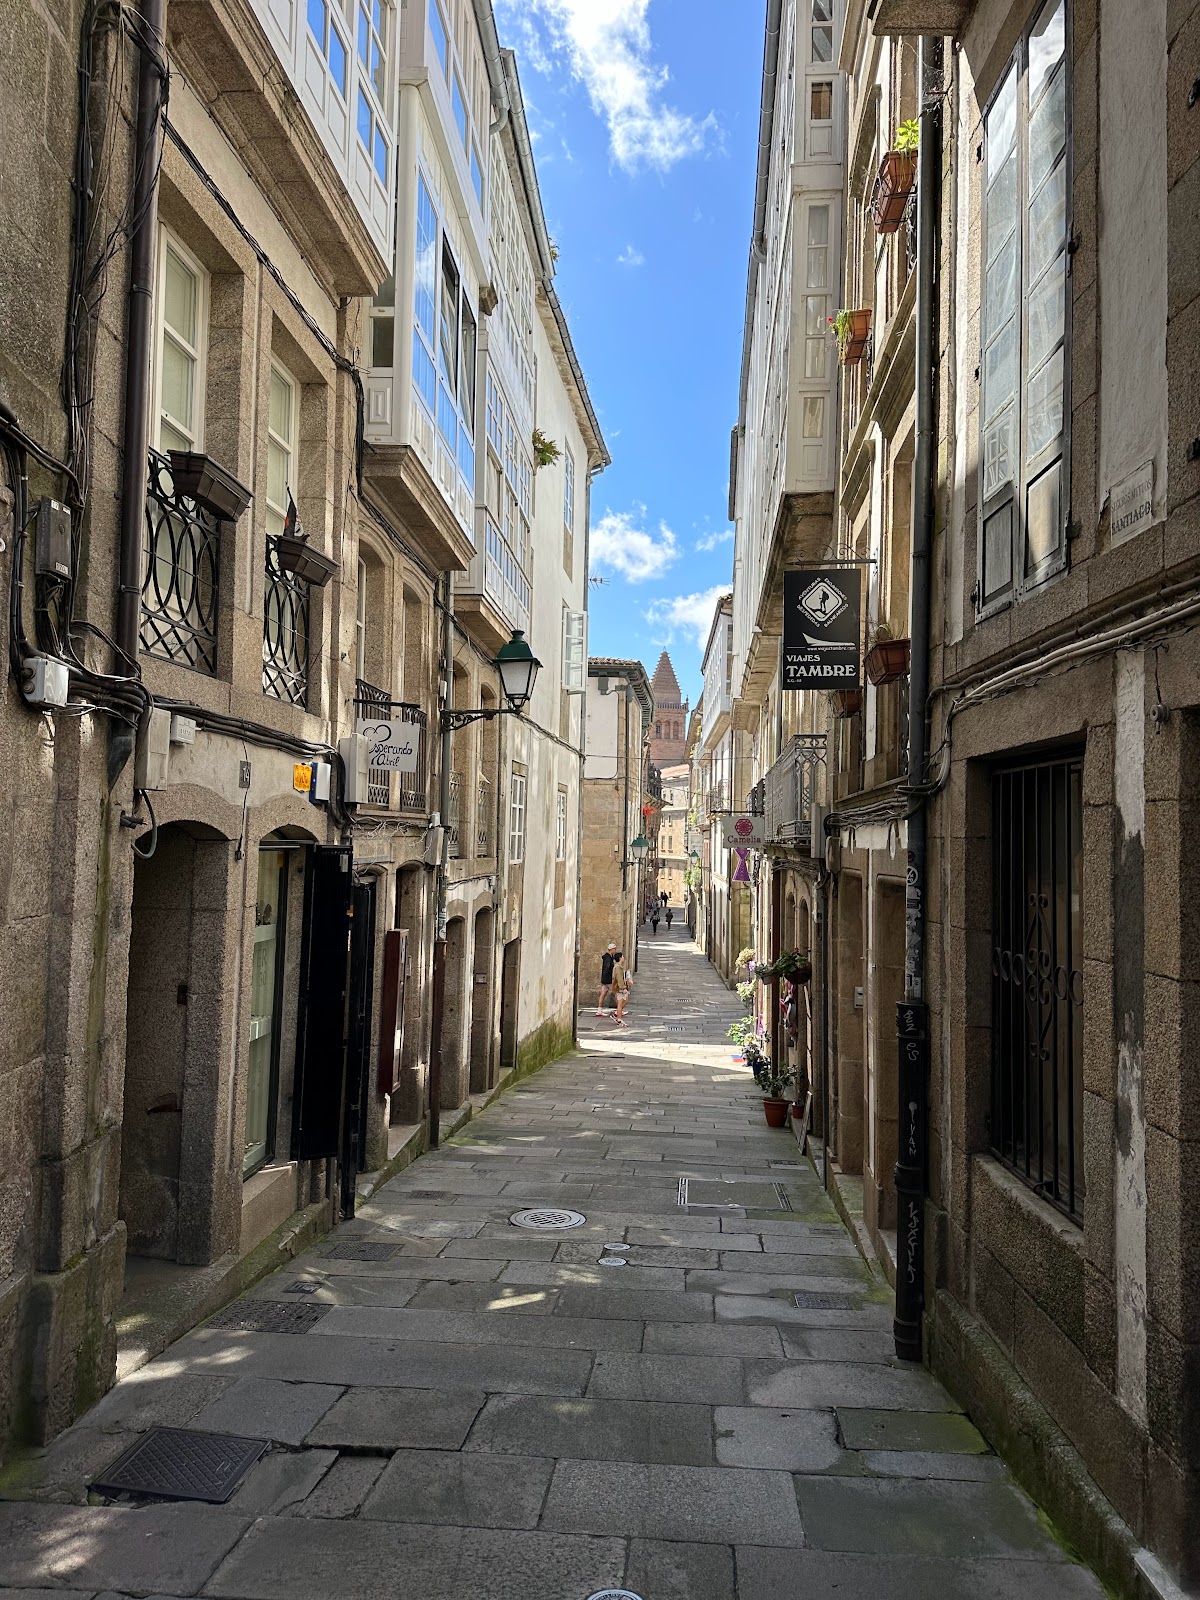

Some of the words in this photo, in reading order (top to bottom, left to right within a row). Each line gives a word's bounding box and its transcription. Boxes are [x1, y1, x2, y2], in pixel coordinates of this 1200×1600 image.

[1111, 501, 1151, 535] SANTIAGO
[799, 577, 821, 600] AVENTURAS
[824, 603, 849, 628] BALNEARIOS
[786, 654, 820, 662] VIAJES
[786, 665, 856, 677] TAMBRE
[727, 835, 761, 844] Camelia
